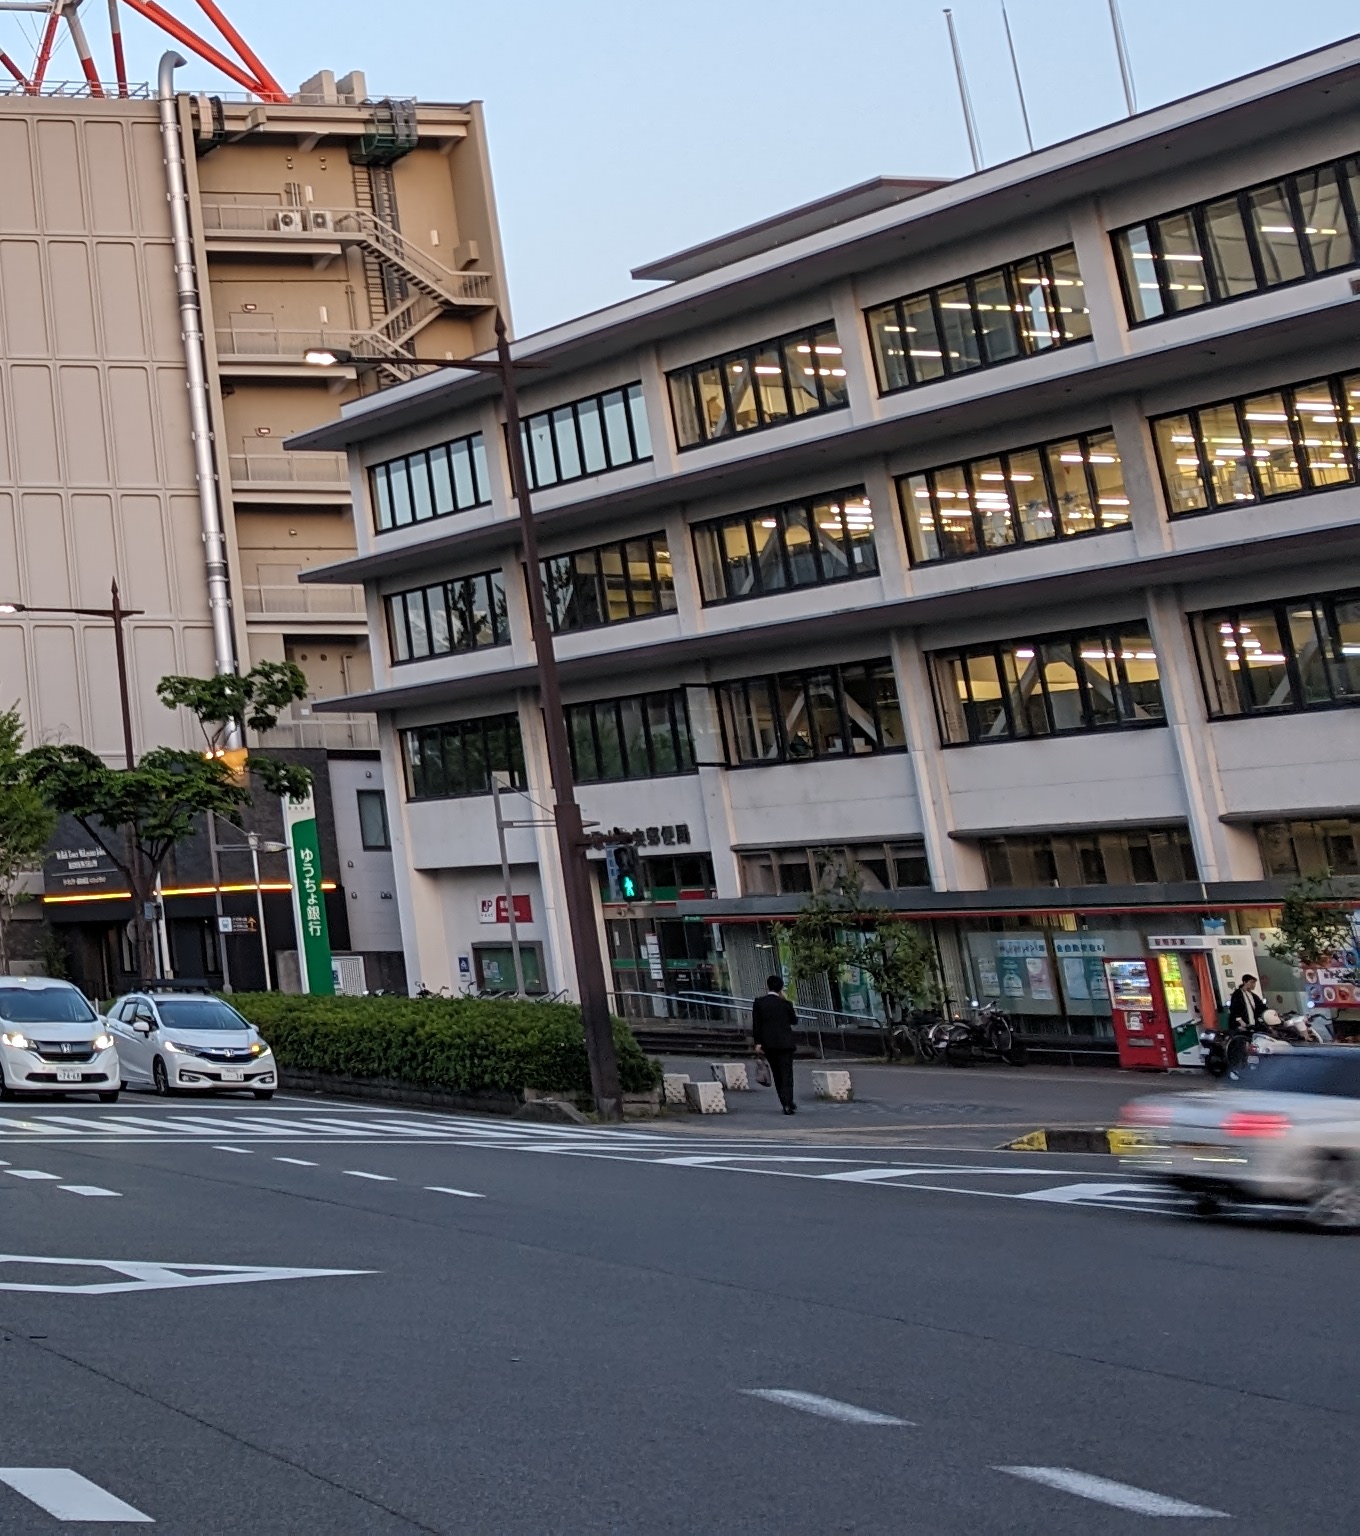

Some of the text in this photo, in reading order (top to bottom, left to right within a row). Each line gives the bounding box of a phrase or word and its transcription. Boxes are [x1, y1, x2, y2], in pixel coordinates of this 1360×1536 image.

[299, 847, 322, 937] ゆうちょ銀行
